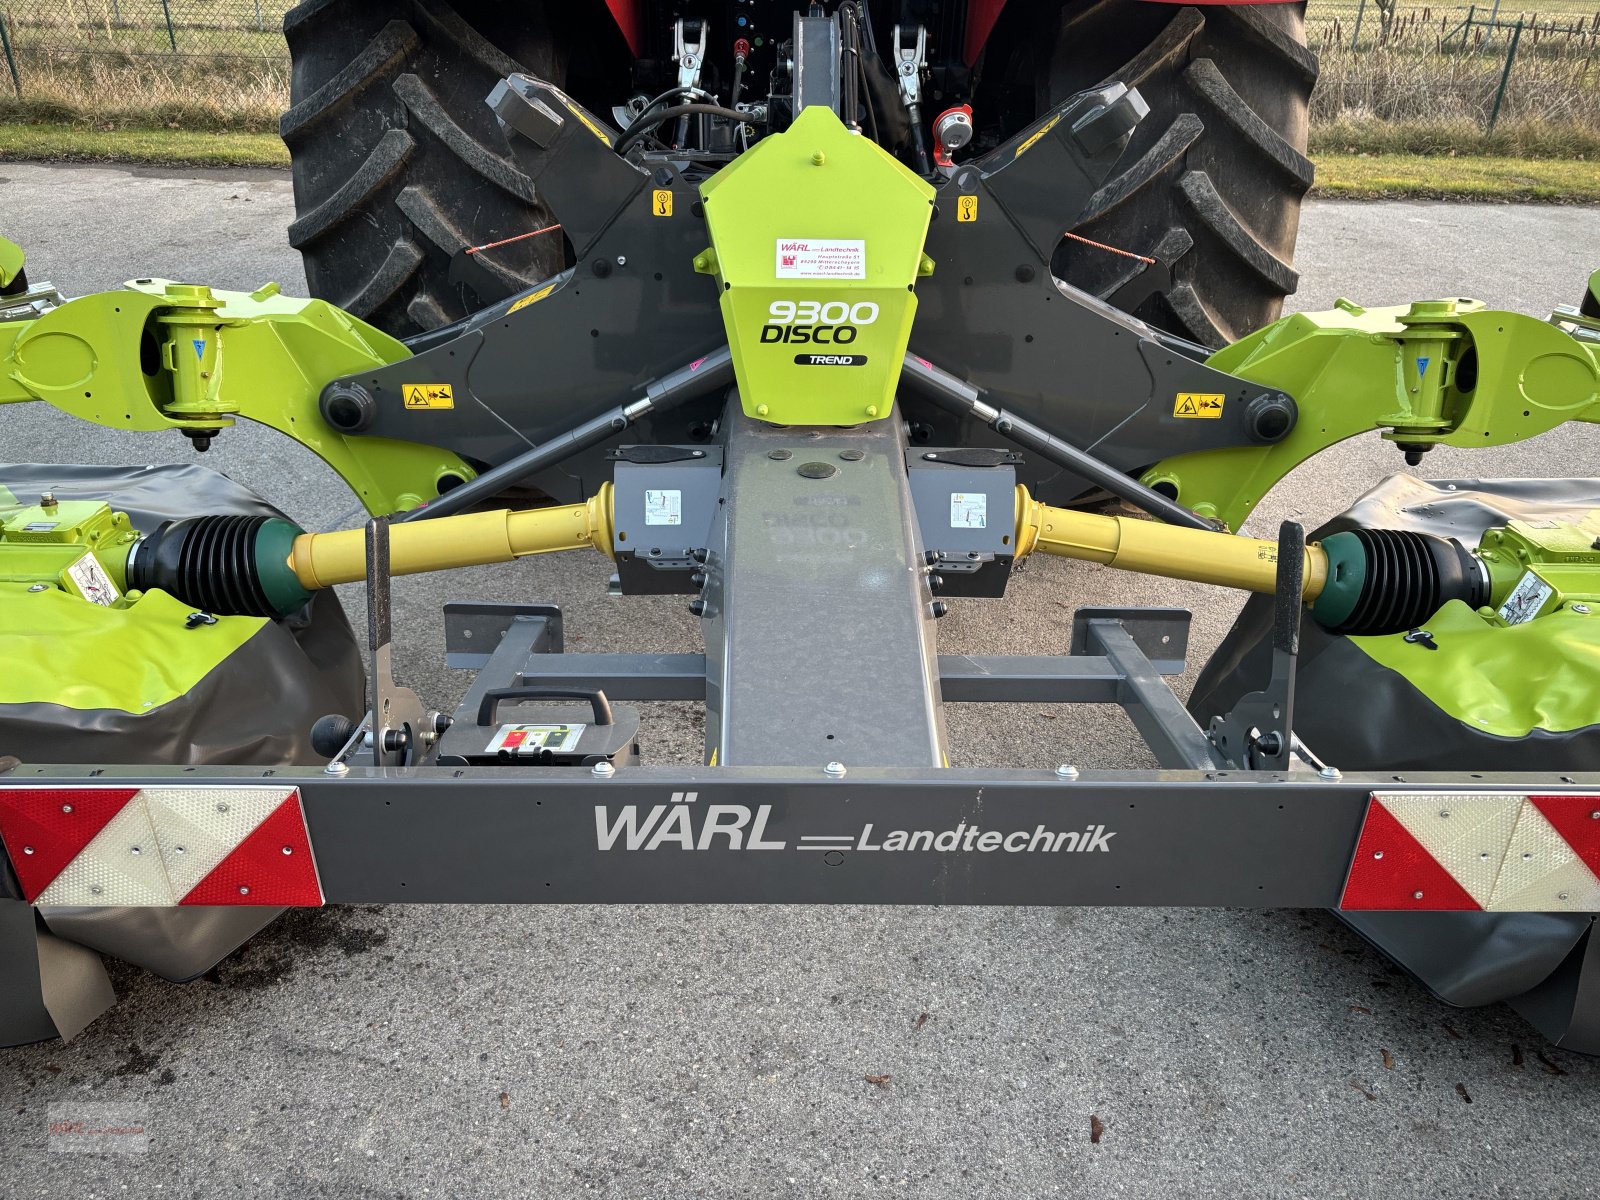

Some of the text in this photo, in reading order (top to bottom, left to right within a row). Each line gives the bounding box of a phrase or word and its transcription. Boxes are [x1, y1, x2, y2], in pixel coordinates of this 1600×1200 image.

[781, 242, 810, 252] WÄRL
[768, 300, 880, 325] 9300
[760, 324, 857, 344] DISCO
[809, 355, 853, 365] TREND
[594, 792, 1117, 853] WÄRL Landtechnik
